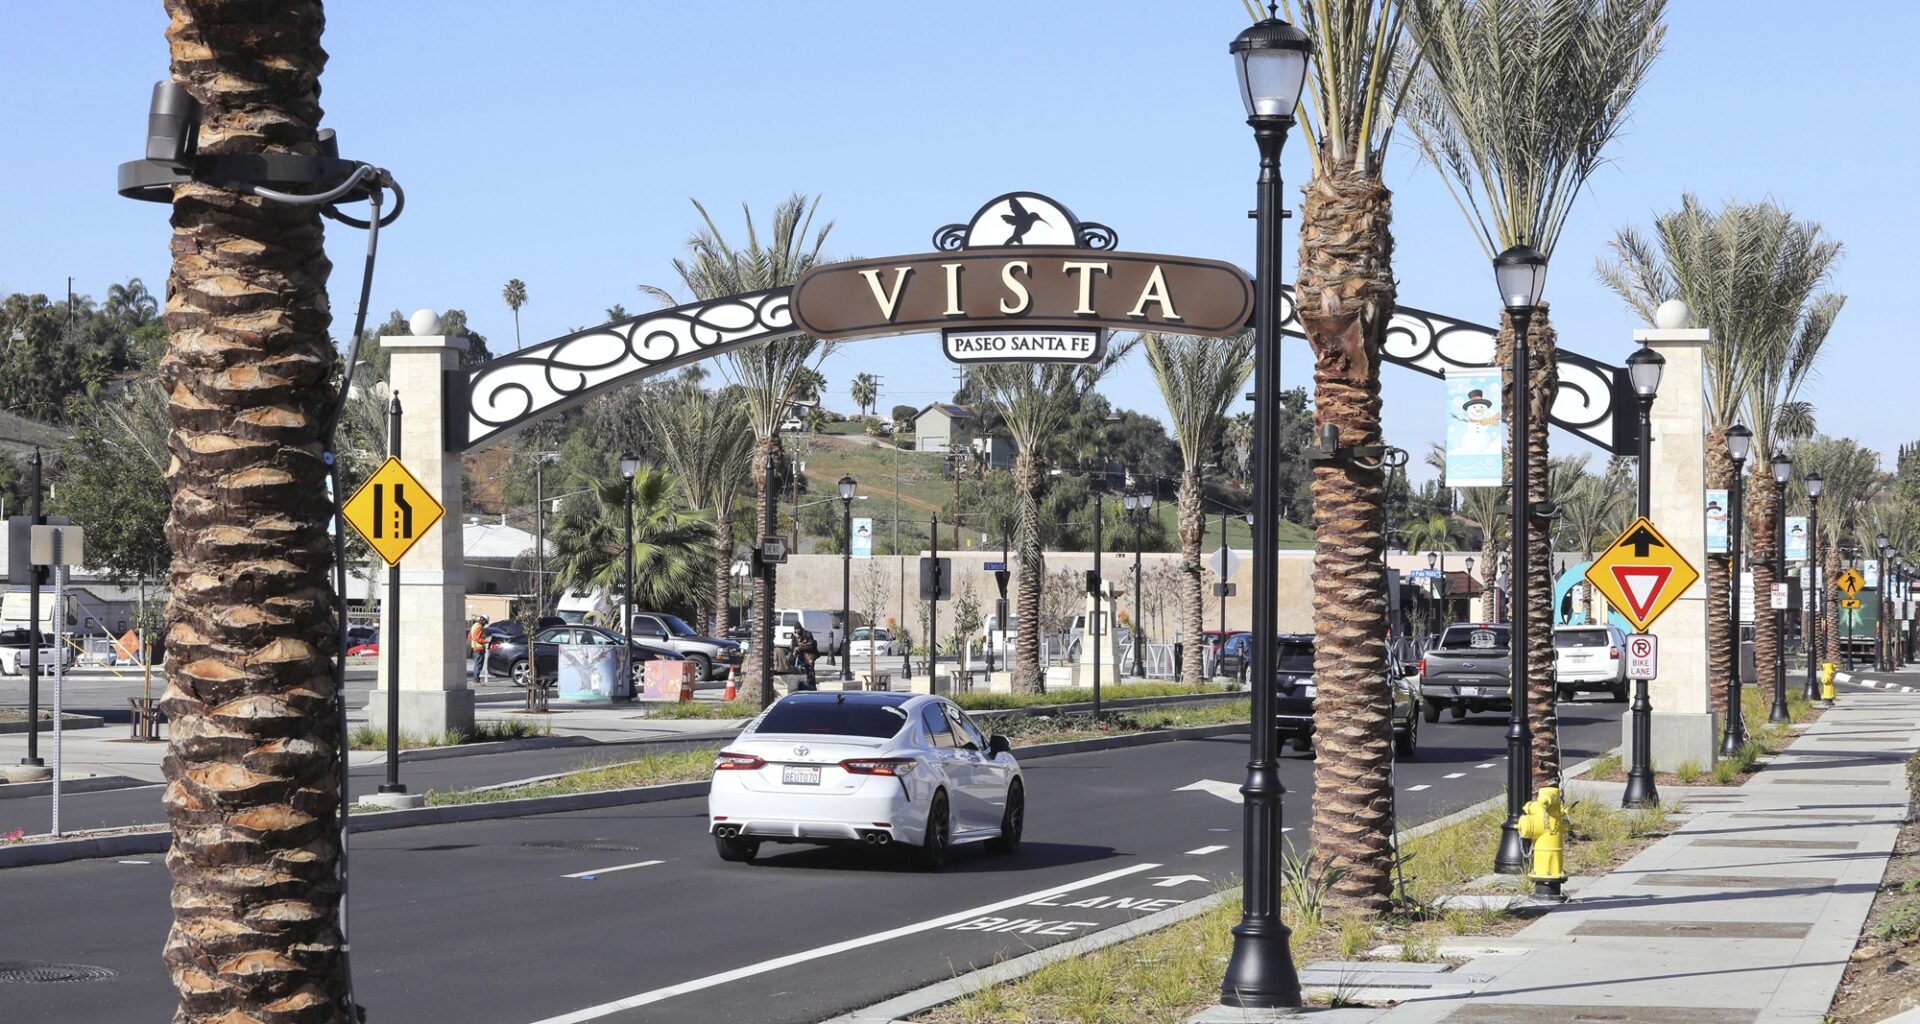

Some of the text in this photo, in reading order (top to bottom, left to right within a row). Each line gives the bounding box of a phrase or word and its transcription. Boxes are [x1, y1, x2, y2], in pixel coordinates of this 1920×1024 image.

[858, 260, 1182, 321] VISTA
[955, 336, 1089, 352] PASEO SANTA FE
[1026, 893, 1187, 911] LANE
[944, 916, 1100, 936] BIKE
